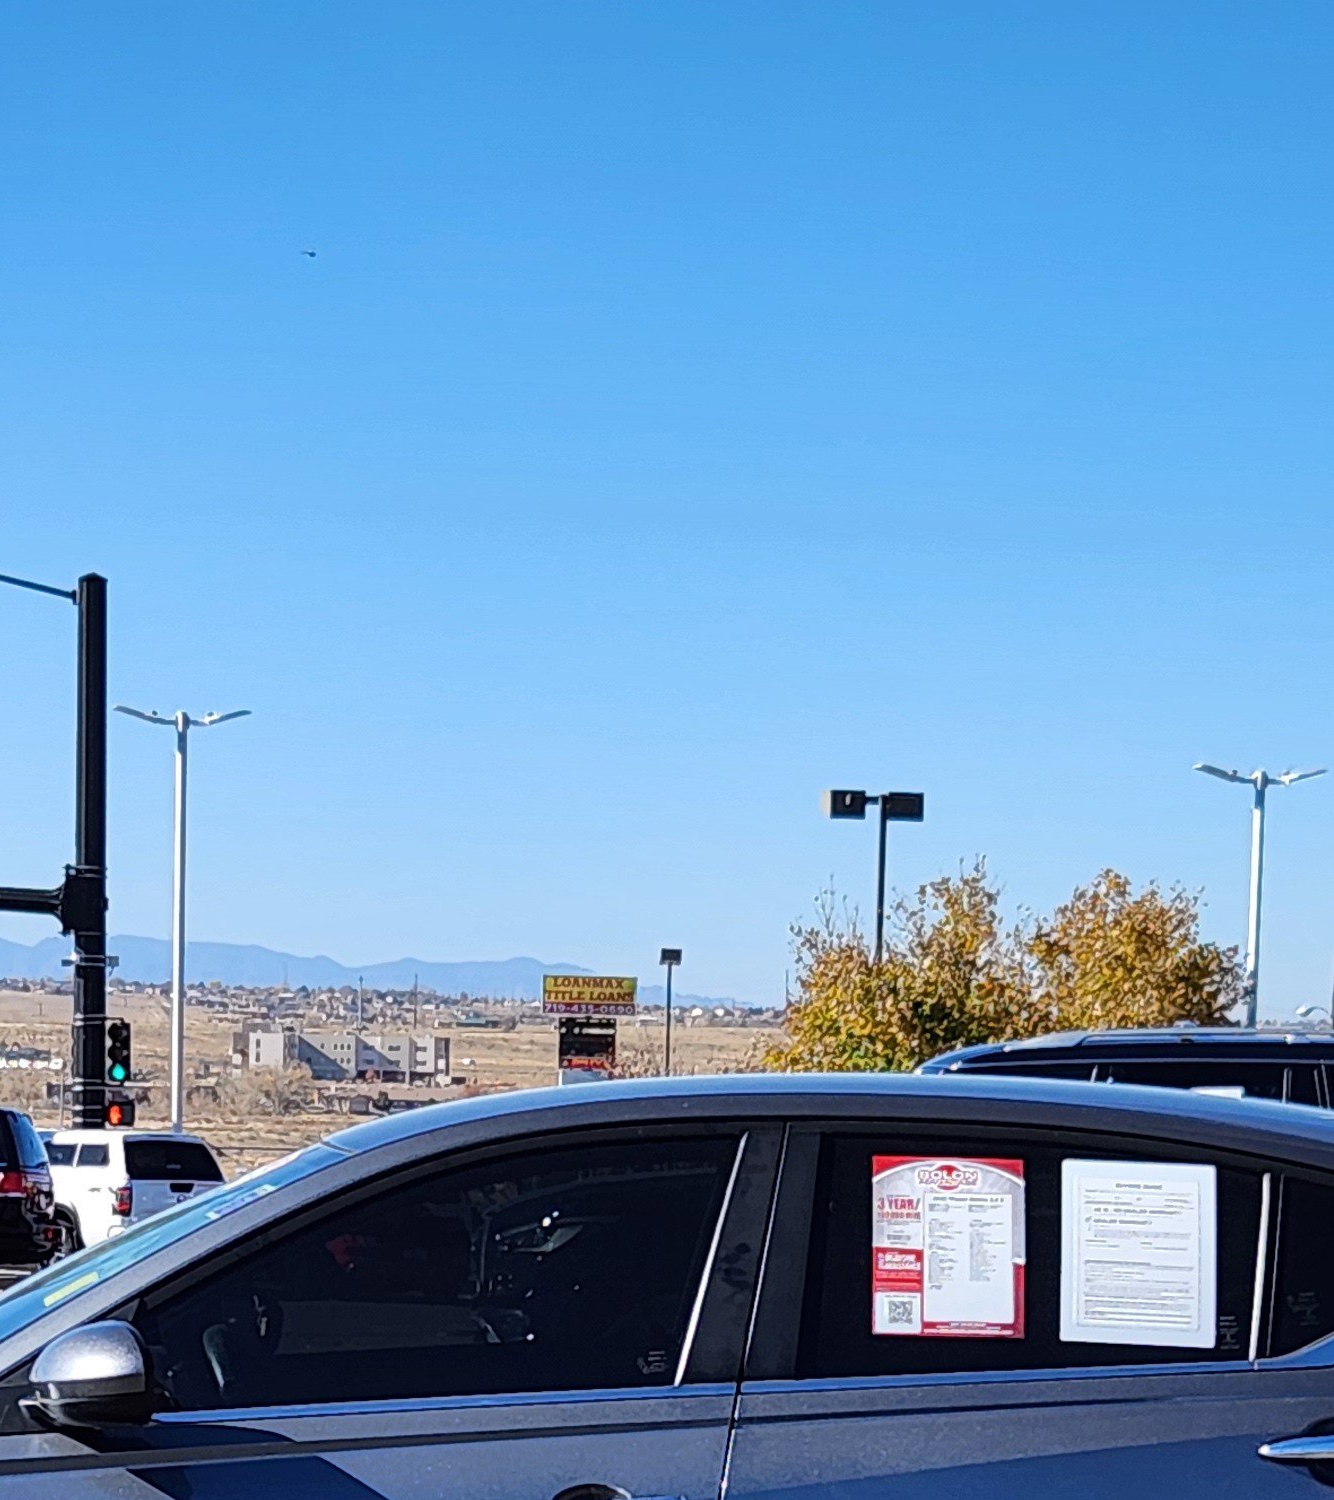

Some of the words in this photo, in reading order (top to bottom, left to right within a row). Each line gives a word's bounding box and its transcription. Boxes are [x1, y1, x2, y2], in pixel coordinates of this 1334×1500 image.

[552, 977, 624, 989] LOANMAX
[546, 990, 586, 1001] TITLE
[589, 991, 634, 1002] LOANS
